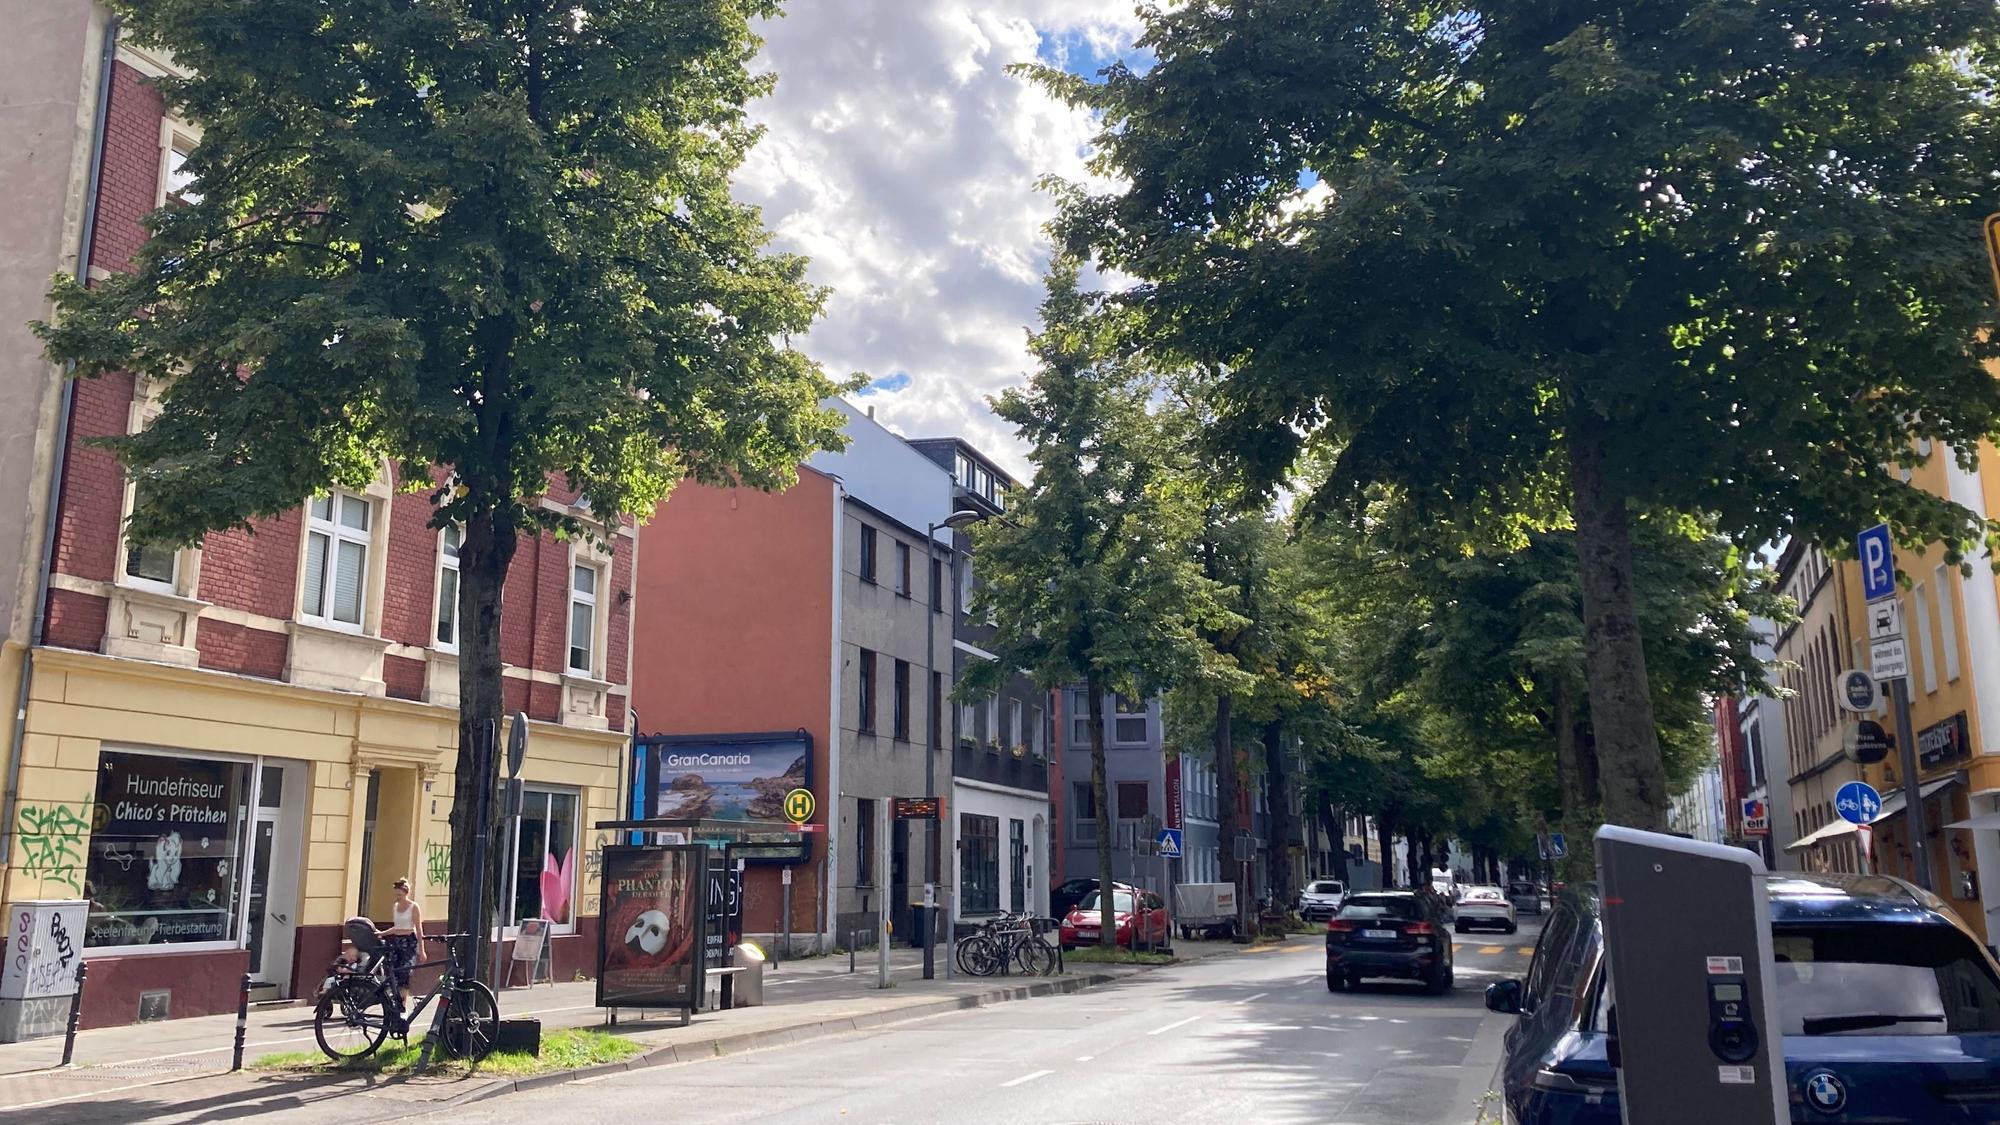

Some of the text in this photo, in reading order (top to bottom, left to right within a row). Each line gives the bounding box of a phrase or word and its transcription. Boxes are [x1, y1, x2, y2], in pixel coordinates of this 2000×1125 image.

[1865, 536, 1884, 591] P
[667, 753, 750, 767] GranCanaria
[126, 773, 224, 799] Hundefriseur
[170, 804, 227, 824] Pfötchen
[1747, 819, 1764, 828] elf
[644, 871, 660, 879] DAS
[618, 879, 685, 891] PHANTOM
